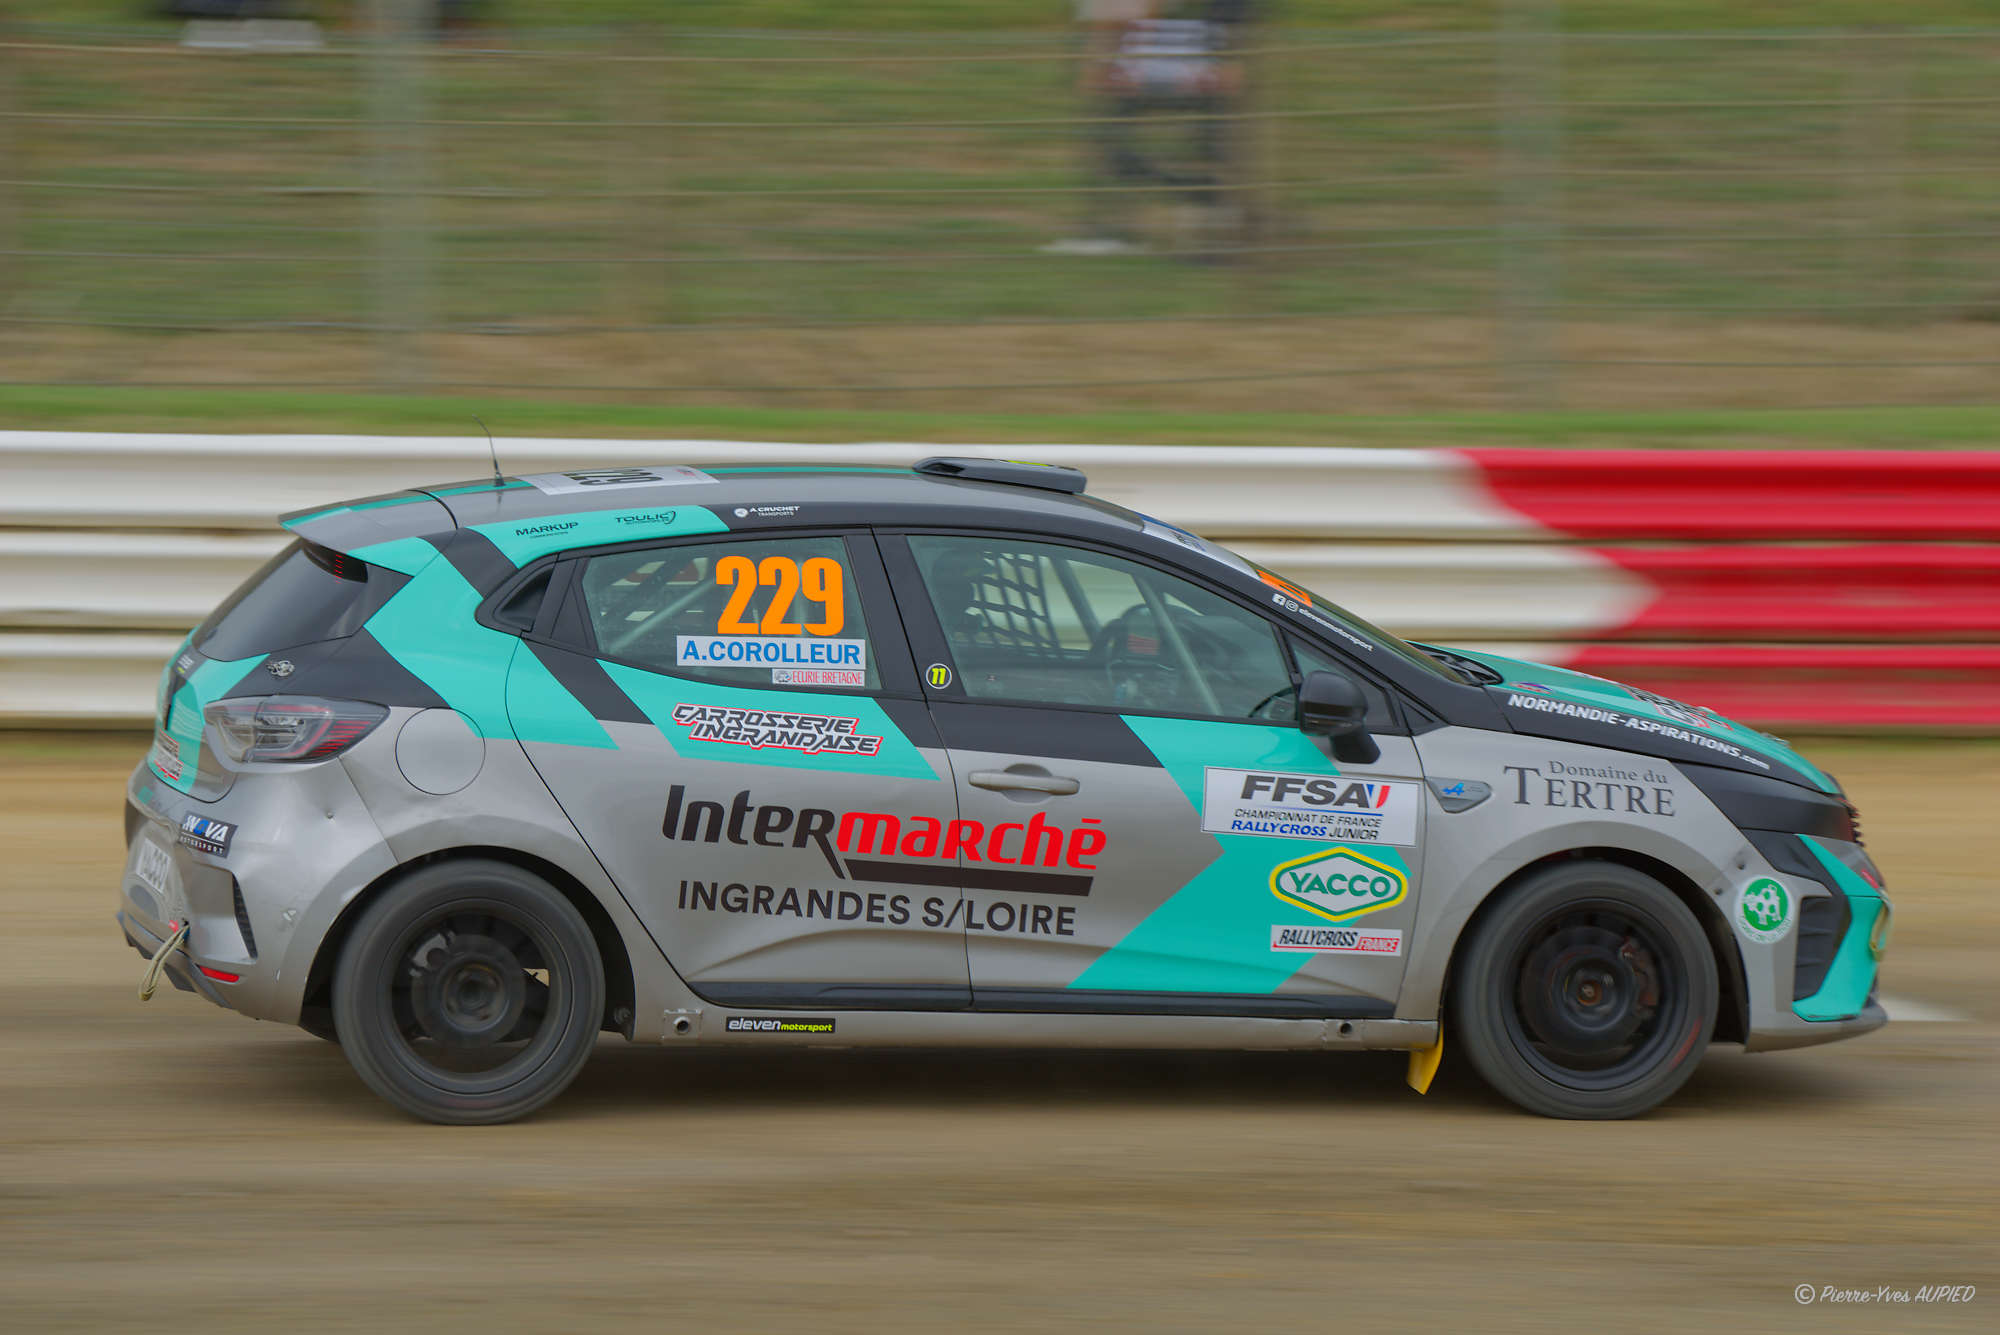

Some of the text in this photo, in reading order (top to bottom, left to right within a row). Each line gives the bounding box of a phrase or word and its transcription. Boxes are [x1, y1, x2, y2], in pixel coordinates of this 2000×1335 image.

[515, 522, 579, 536] MARKUP
[715, 555, 844, 636] 229
[682, 640, 860, 665] A.COROLLEUR
[792, 671, 863, 685] ECURIE BRETAGNE
[674, 705, 855, 736] CARROSSERIE
[1508, 694, 1770, 770] NORMANDIE-ASPIRATIONS.com
[692, 722, 878, 752] INGRANDAISE
[1549, 760, 1667, 784] Domaine du
[1240, 774, 1371, 809] FFSA
[1504, 765, 1676, 817] TERTRE
[1231, 819, 1379, 841] RALLYCROSS JUNIOR
[1234, 807, 1382, 829] CHAMPIONNAT DE FRANCE
[1289, 871, 1391, 898] YACCO
[678, 880, 1076, 936] INGRANDES S/LOIRE
[1279, 929, 1398, 951] RALLYCROSS FRANCE
